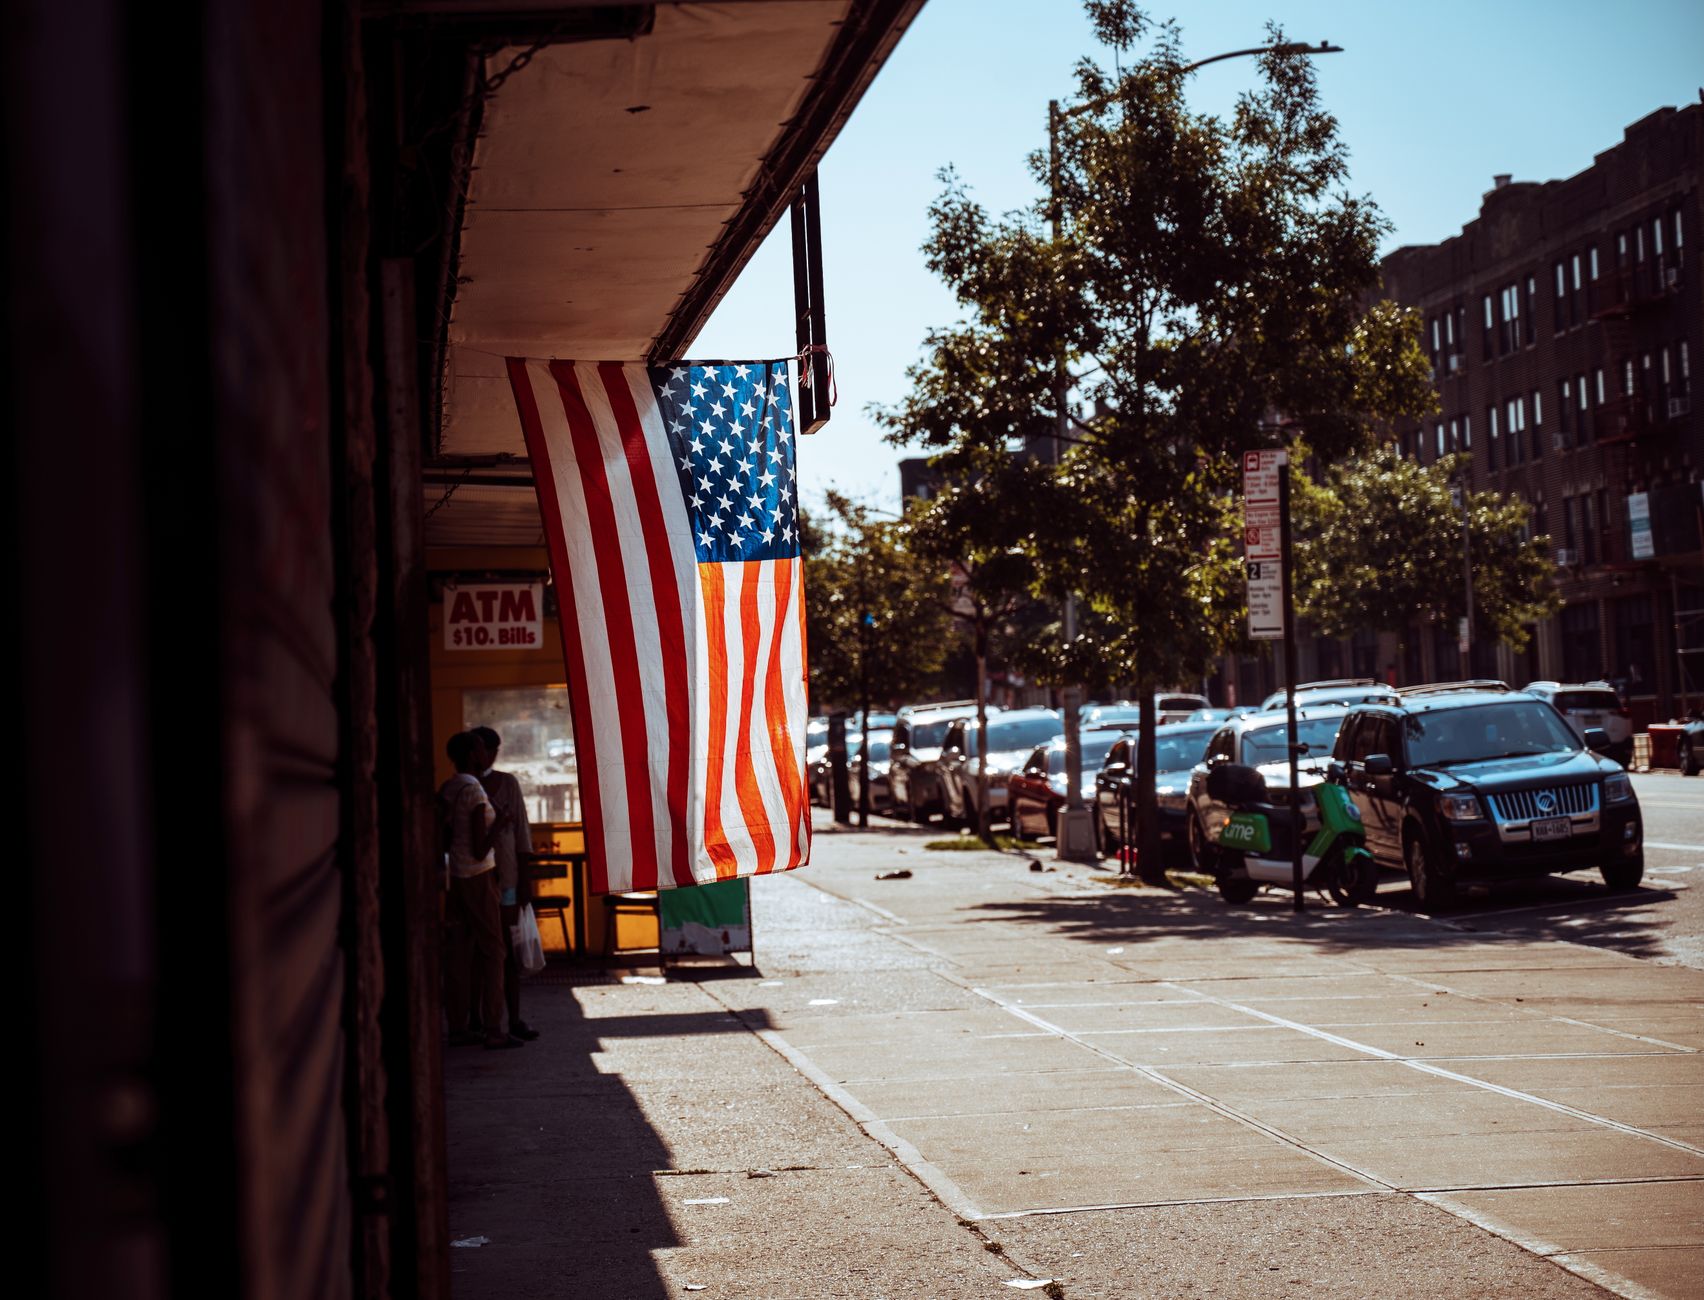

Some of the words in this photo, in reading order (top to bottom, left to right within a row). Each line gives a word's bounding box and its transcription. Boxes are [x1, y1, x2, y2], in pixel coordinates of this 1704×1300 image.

[1250, 564, 1258, 579] 2
[449, 590, 537, 624] ATM
[453, 626, 495, 646] $10.
[498, 627, 536, 645] Bills
